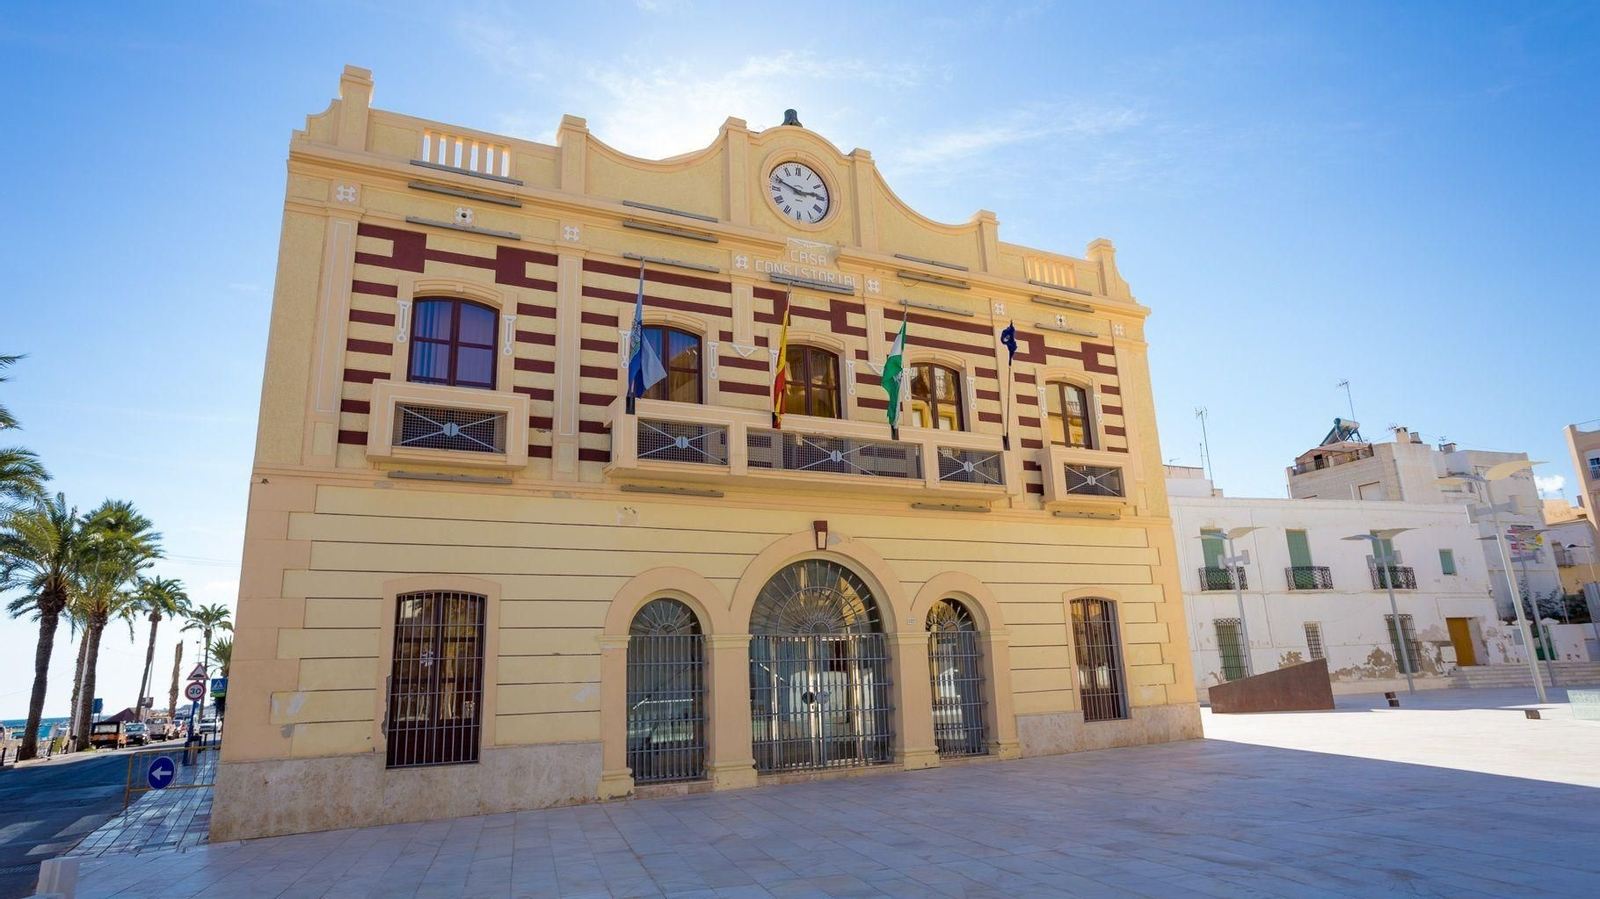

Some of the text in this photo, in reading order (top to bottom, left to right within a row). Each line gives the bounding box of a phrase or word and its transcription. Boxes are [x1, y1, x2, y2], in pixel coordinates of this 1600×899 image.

[790, 250, 827, 265] CASA
[755, 260, 857, 287] CONSISTORIAL
[189, 687, 202, 695] 30
